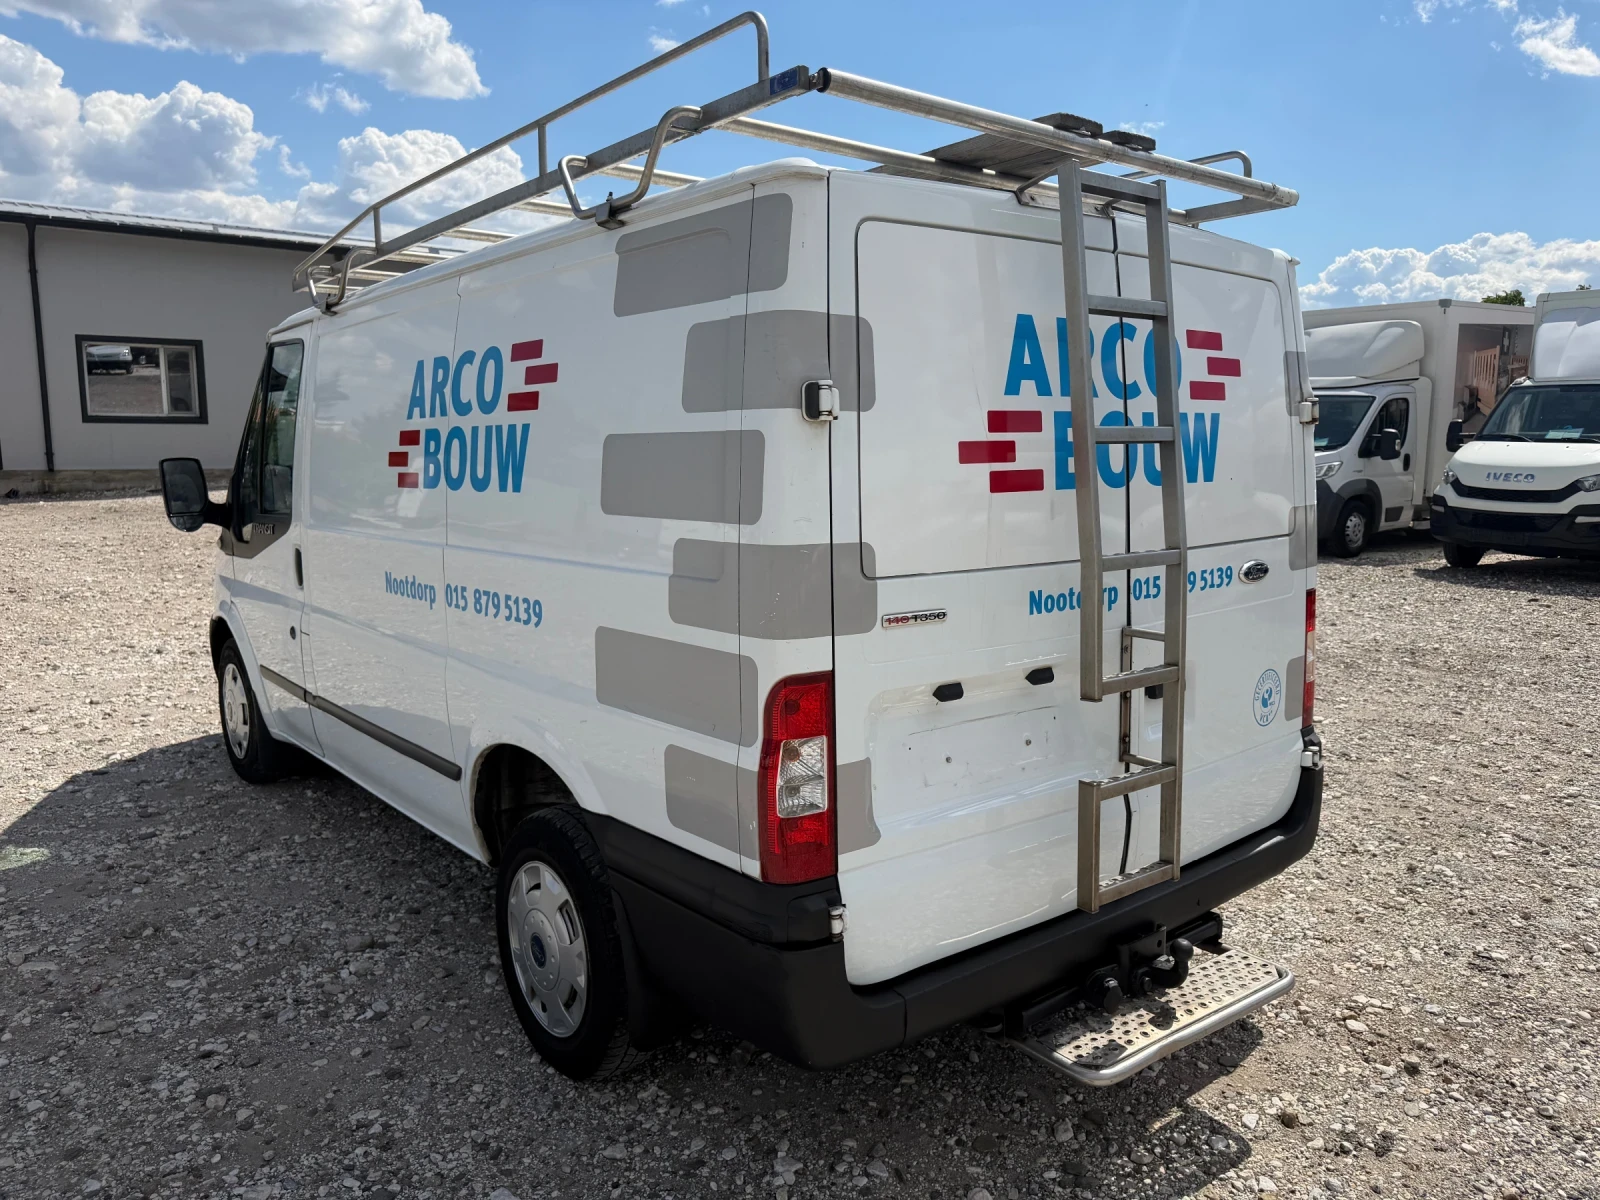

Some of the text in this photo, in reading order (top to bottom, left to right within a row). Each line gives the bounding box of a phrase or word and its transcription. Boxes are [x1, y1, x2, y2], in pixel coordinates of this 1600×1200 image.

[406, 345, 504, 420] ARCO
[423, 423, 531, 493] BOUW
[1486, 471, 1536, 483] IVECO
[252, 522, 275, 535] TRANSIT
[385, 571, 543, 628] Nootdorp 015 879 5139
[1029, 586, 1119, 615] Nootrp
[1132, 576, 1161, 601] 015
[1200, 565, 1233, 592] 5139
